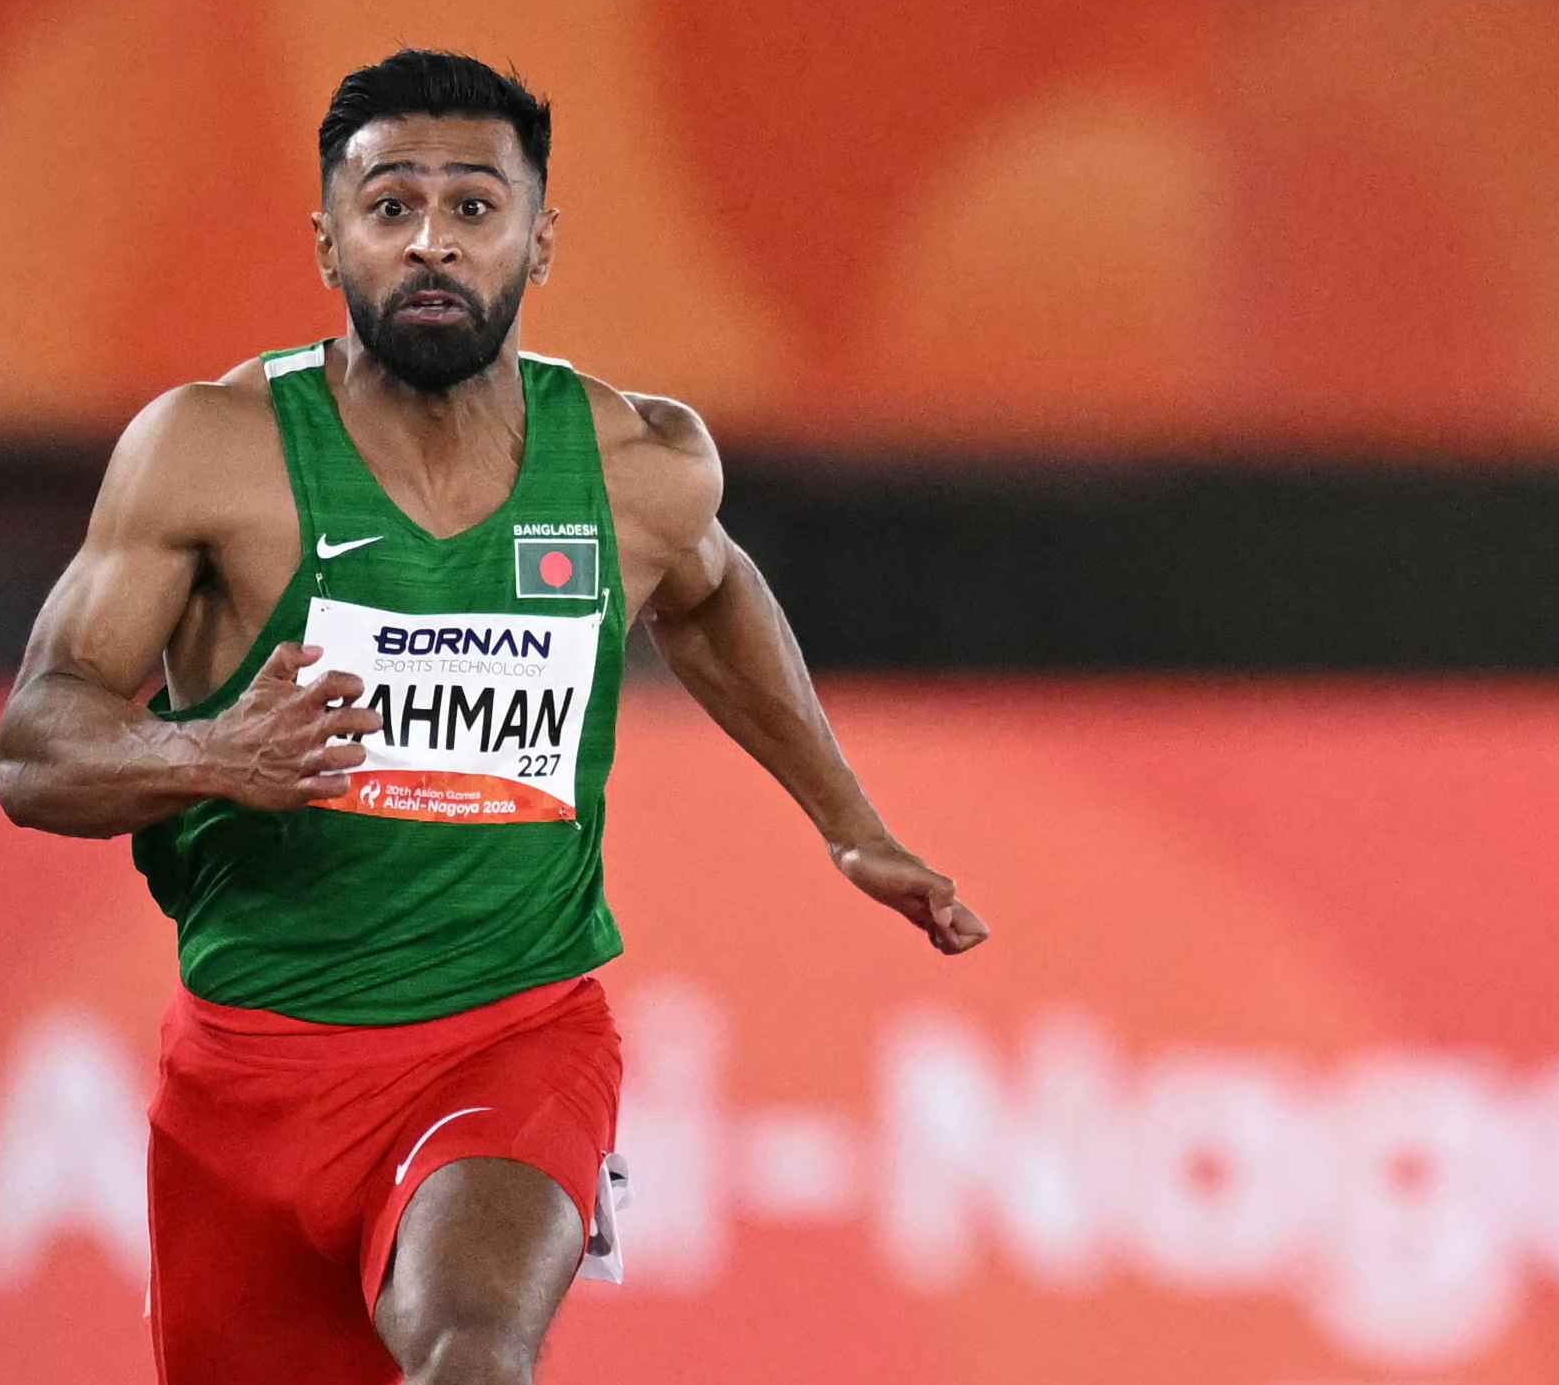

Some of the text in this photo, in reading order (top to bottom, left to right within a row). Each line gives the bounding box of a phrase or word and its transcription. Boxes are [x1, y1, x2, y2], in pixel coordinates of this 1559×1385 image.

[513, 524, 598, 536] BANGLADESH
[372, 625, 552, 659] BORNAN
[374, 658, 546, 677] SPORTS TECHNOLOGY
[325, 684, 574, 752] AHMAN
[518, 754, 561, 778] 227
[386, 785, 481, 800] 20th Asian Games
[383, 797, 516, 817] Aichi-Nagoya 2026
